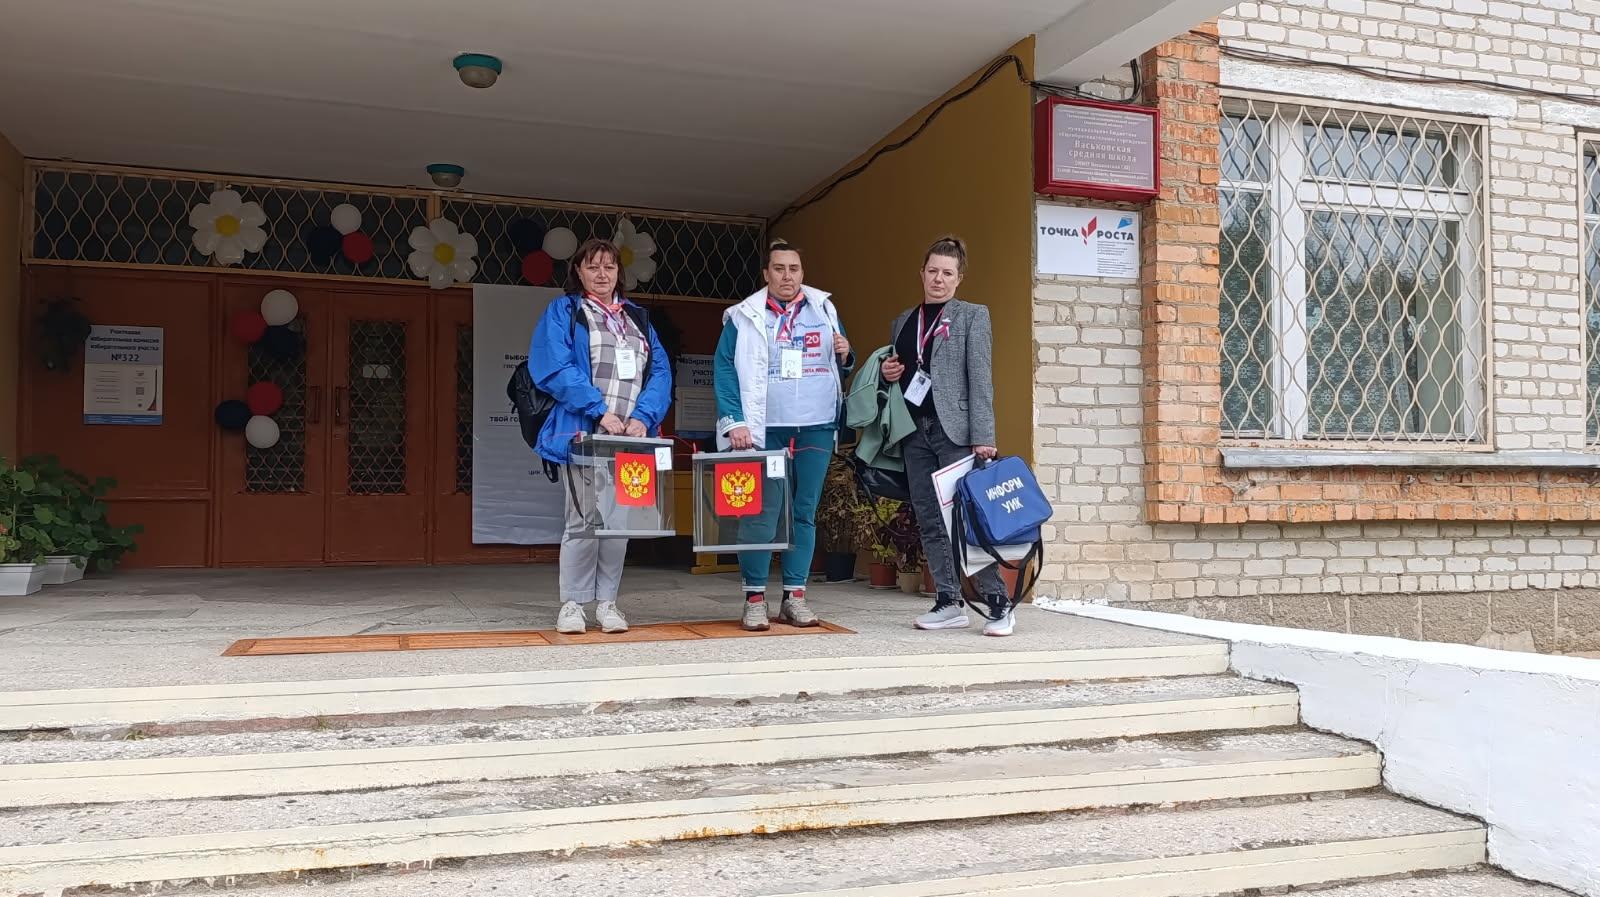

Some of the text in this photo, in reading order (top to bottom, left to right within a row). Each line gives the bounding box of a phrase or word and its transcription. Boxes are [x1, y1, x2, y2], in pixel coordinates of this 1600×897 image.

[1040, 226, 1134, 240] ТОЧКА РОСТА
[805, 334, 819, 345] 20
[111, 353, 140, 361] №322
[659, 452, 666, 465] 2
[771, 460, 777, 472] 1
[985, 477, 1024, 501] ИНФОРМ
[1001, 497, 1024, 514] УИК
